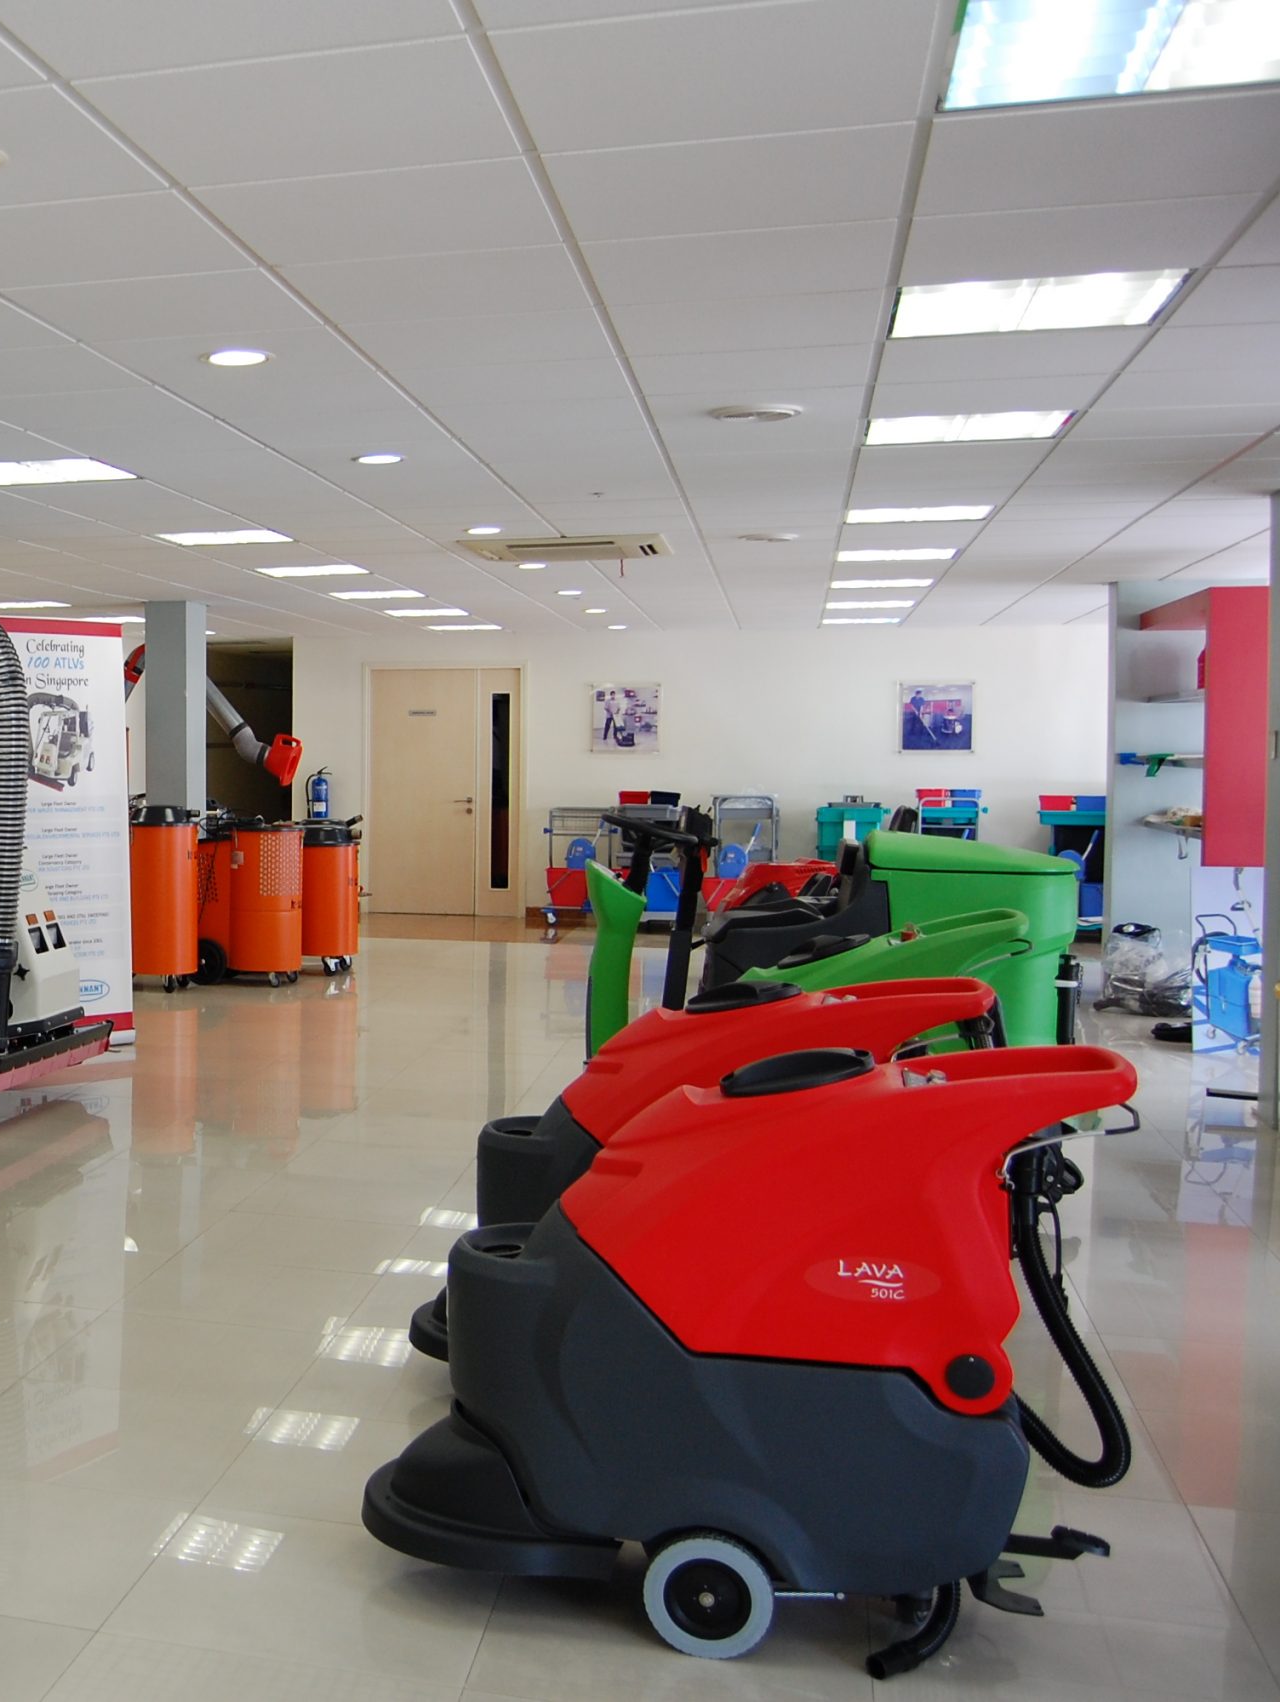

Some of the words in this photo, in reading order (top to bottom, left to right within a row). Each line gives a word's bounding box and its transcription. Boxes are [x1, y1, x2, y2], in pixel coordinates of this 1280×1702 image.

[26, 639, 85, 658] Celebrating
[27, 656, 50, 669] 100
[54, 657, 85, 670] ATLVs
[35, 673, 89, 692] Singapore
[837, 1259, 905, 1280] LAVA
